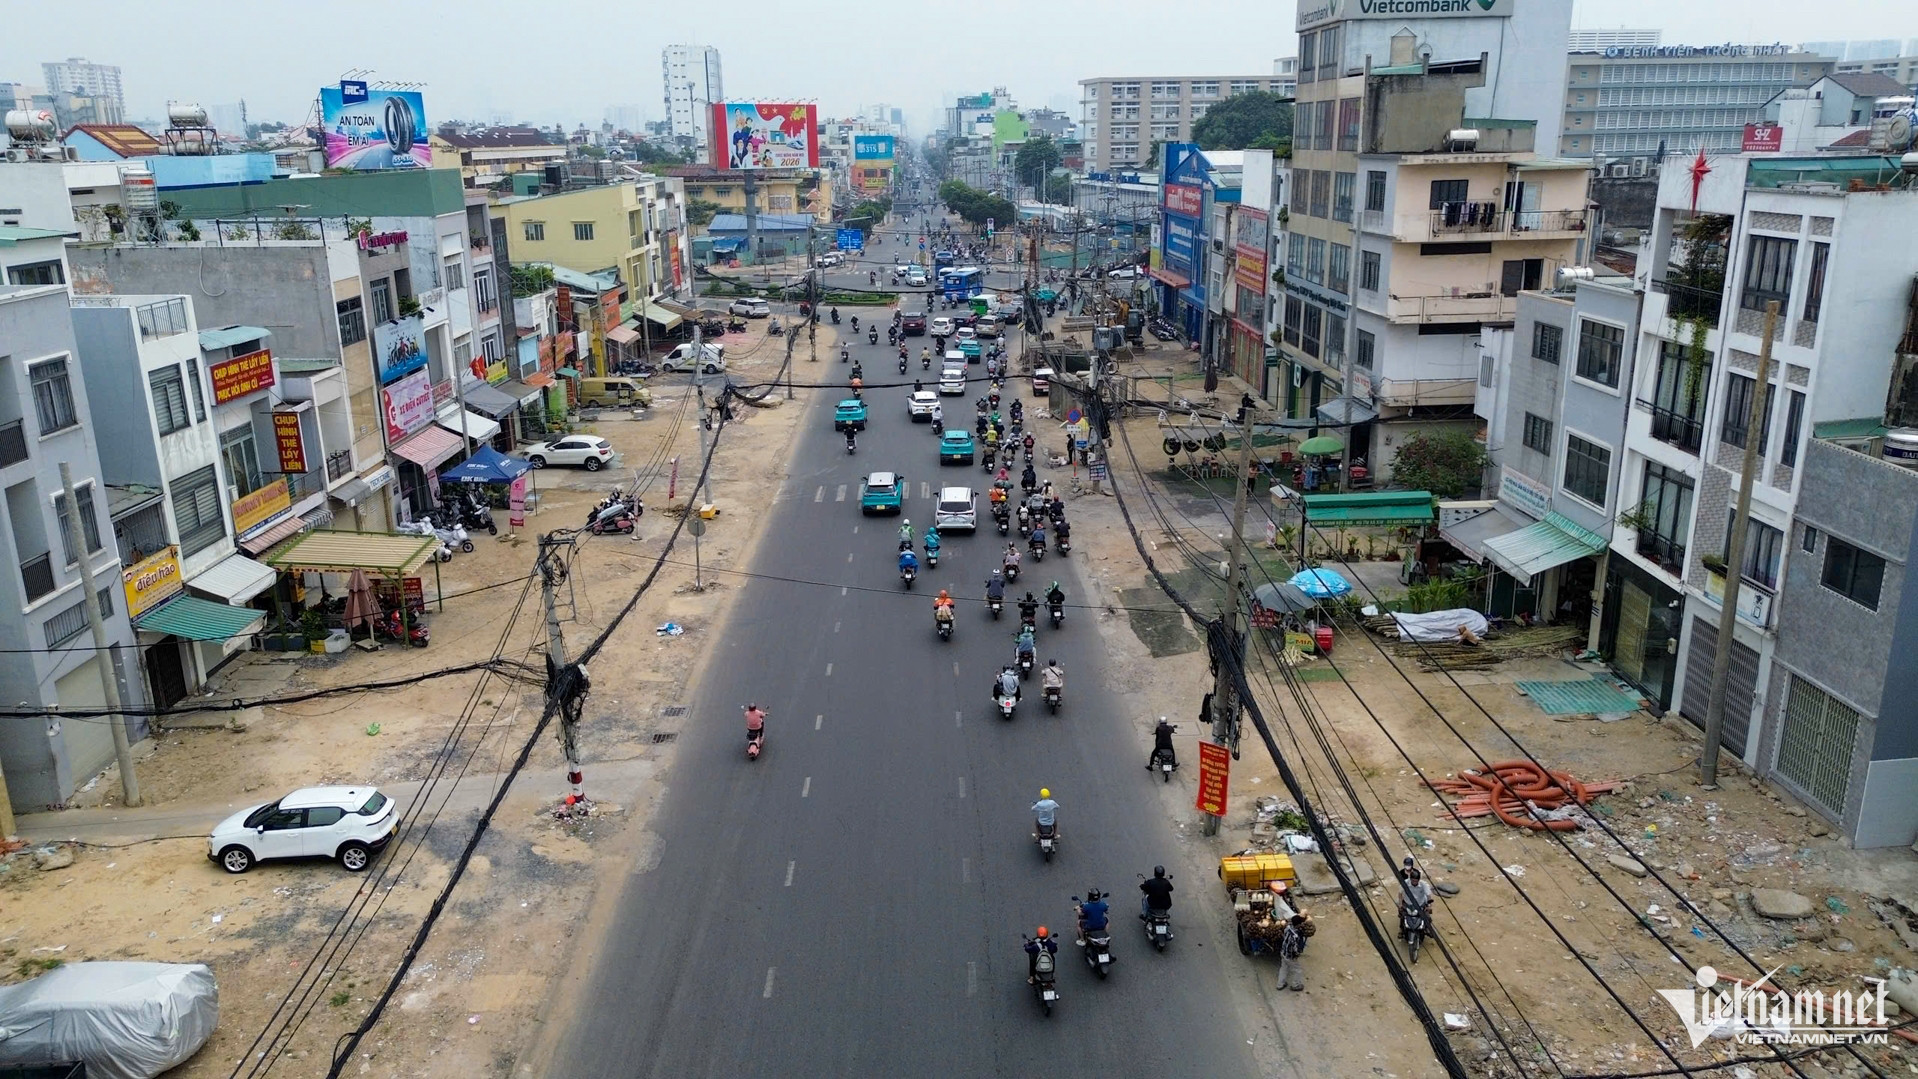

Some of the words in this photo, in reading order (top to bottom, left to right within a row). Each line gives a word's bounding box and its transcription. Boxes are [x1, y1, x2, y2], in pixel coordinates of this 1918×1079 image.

[1361, 0, 1470, 14] Vietcombank
[1299, 7, 1329, 25] Vietcombank
[1623, 45, 1657, 58] BỆNH
[1664, 44, 1694, 58] VIỆN
[339, 115, 352, 126] AN
[353, 113, 375, 126] TOÀN
[348, 134, 359, 146] ÊM
[1754, 129, 1771, 140] SHZ
[865, 144, 877, 152] 315
[780, 158, 800, 166] 2026
[227, 362, 240, 376] HÌNH
[240, 357, 249, 371] THẺ
[274, 416, 297, 426] CHỤP
[277, 426, 298, 436] HÌNH
[281, 437, 297, 447] THẺ
[282, 448, 299, 458] LẤY
